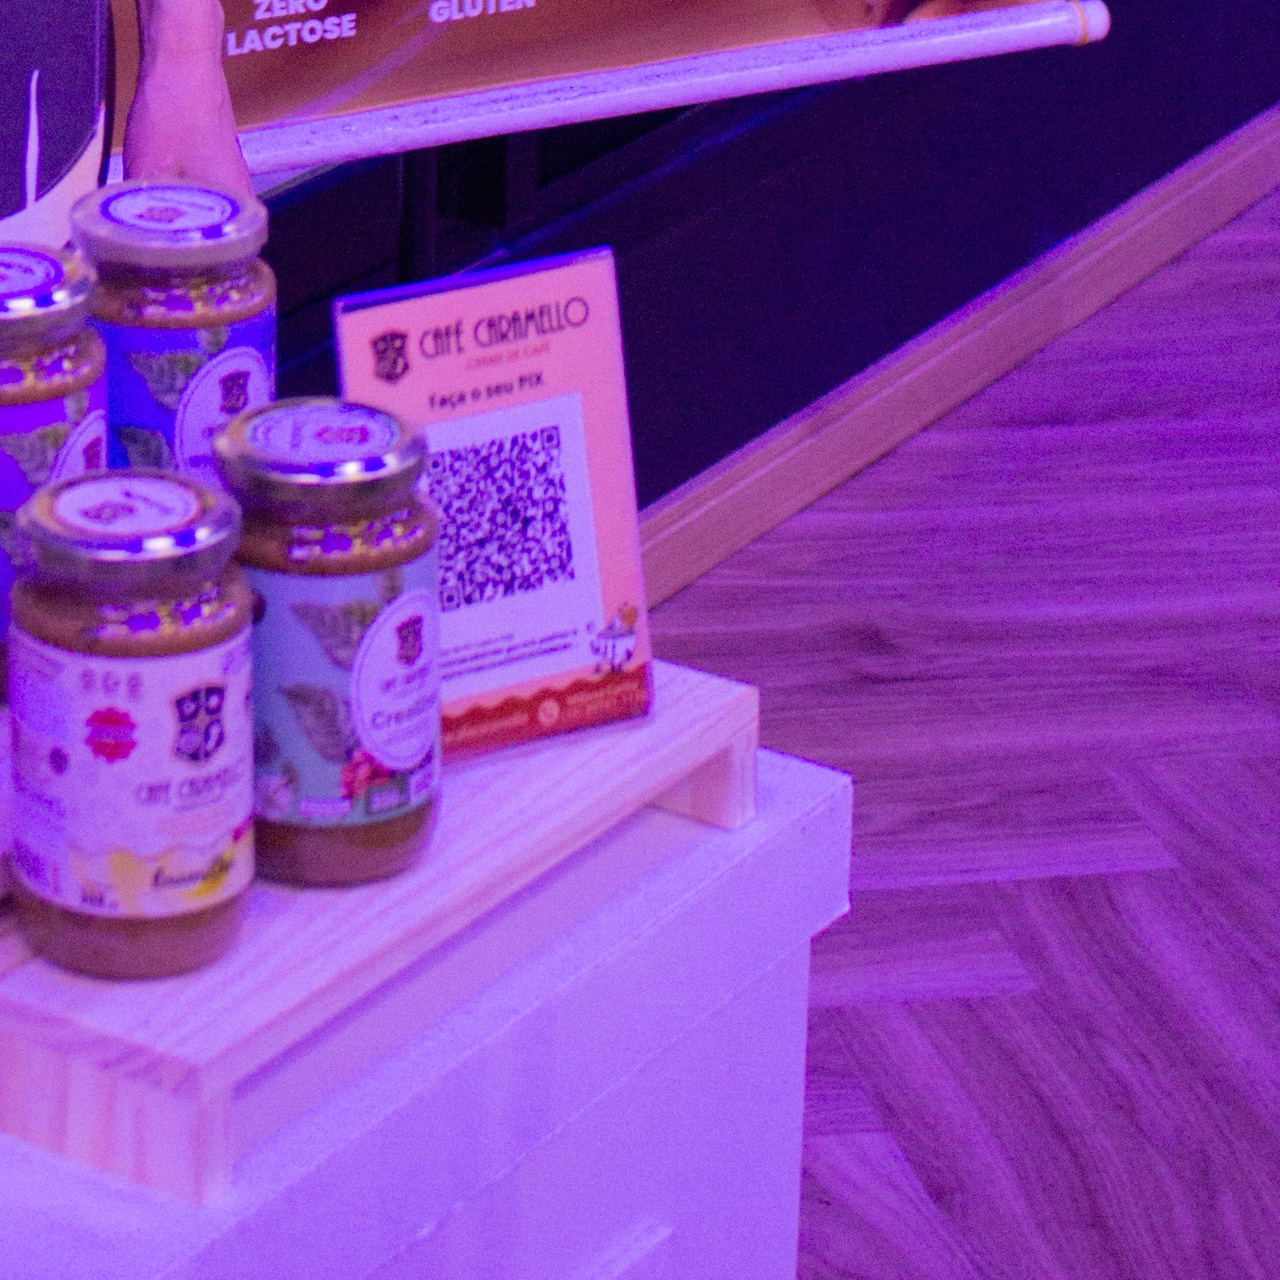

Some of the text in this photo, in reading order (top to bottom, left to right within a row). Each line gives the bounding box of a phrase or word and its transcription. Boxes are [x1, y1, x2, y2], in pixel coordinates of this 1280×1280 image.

[226, 12, 357, 56] LACTOSE
[473, 296, 590, 348] CARAMELLO
[429, 392, 467, 410] Faça
